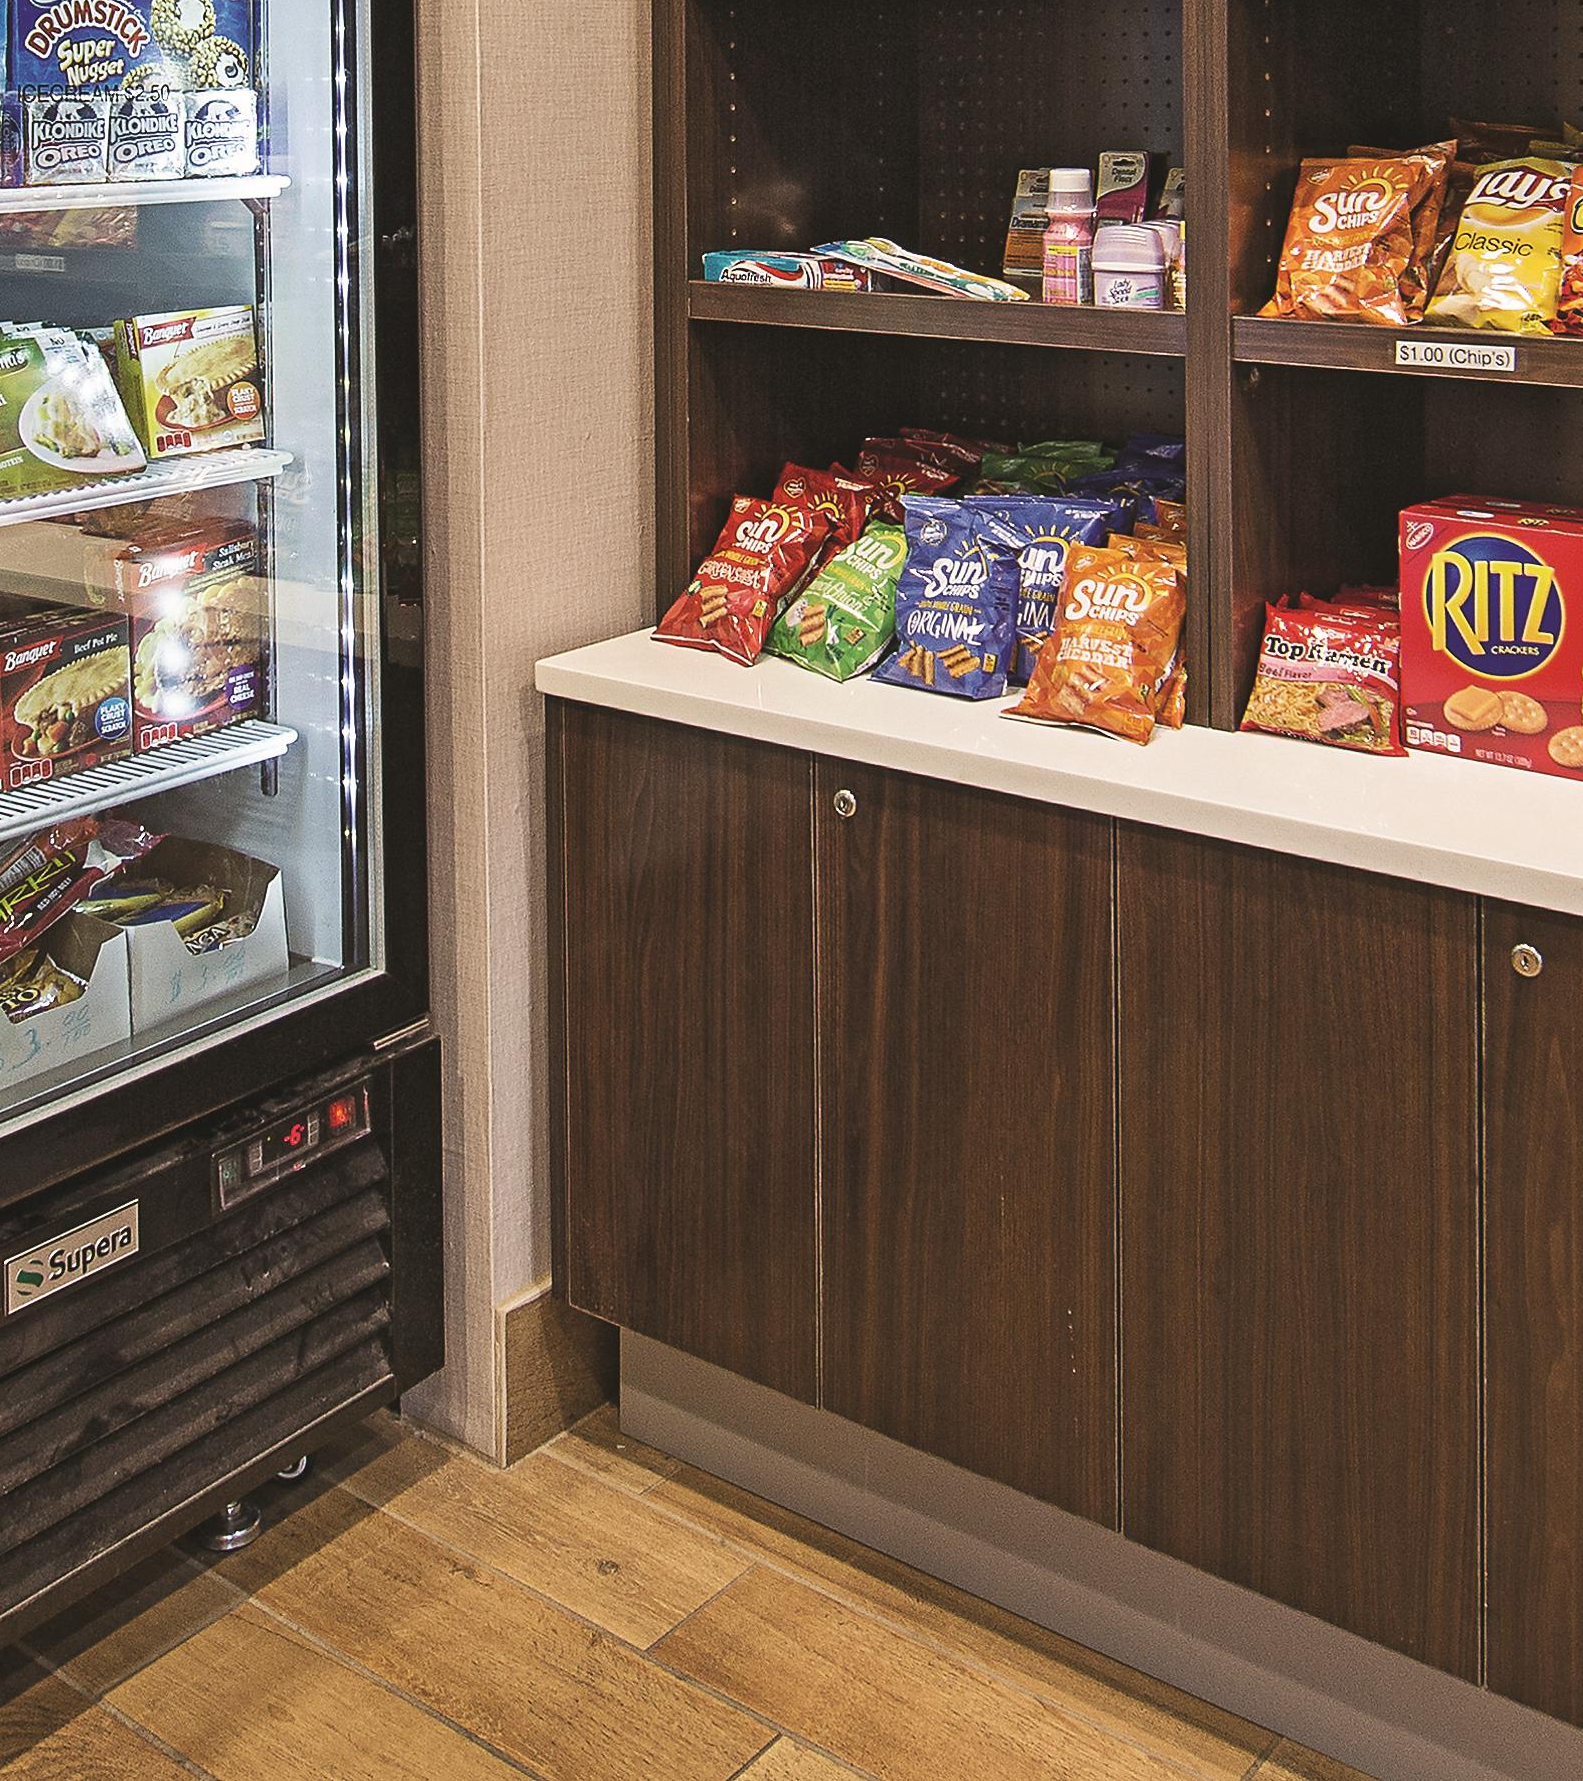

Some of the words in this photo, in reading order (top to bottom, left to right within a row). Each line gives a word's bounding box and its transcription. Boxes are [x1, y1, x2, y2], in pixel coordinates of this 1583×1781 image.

[18, 84, 118, 102] ICECREAM
[33, 121, 104, 148] KLONDIKE
[1454, 232, 1533, 258] Classic
[1400, 347, 1444, 366] $1.00
[1449, 347, 1511, 367] (Chip's)
[942, 584, 981, 599] CHIPS
[1431, 551, 1555, 656] RITZ
[1089, 606, 1141, 626] CHIPS
[4, 640, 56, 672] Banquet
[1265, 634, 1304, 662] Top
[1308, 644, 1389, 676] Ramen
[1491, 644, 1540, 656] CRACKERS
[48, 1226, 133, 1282] Supera
